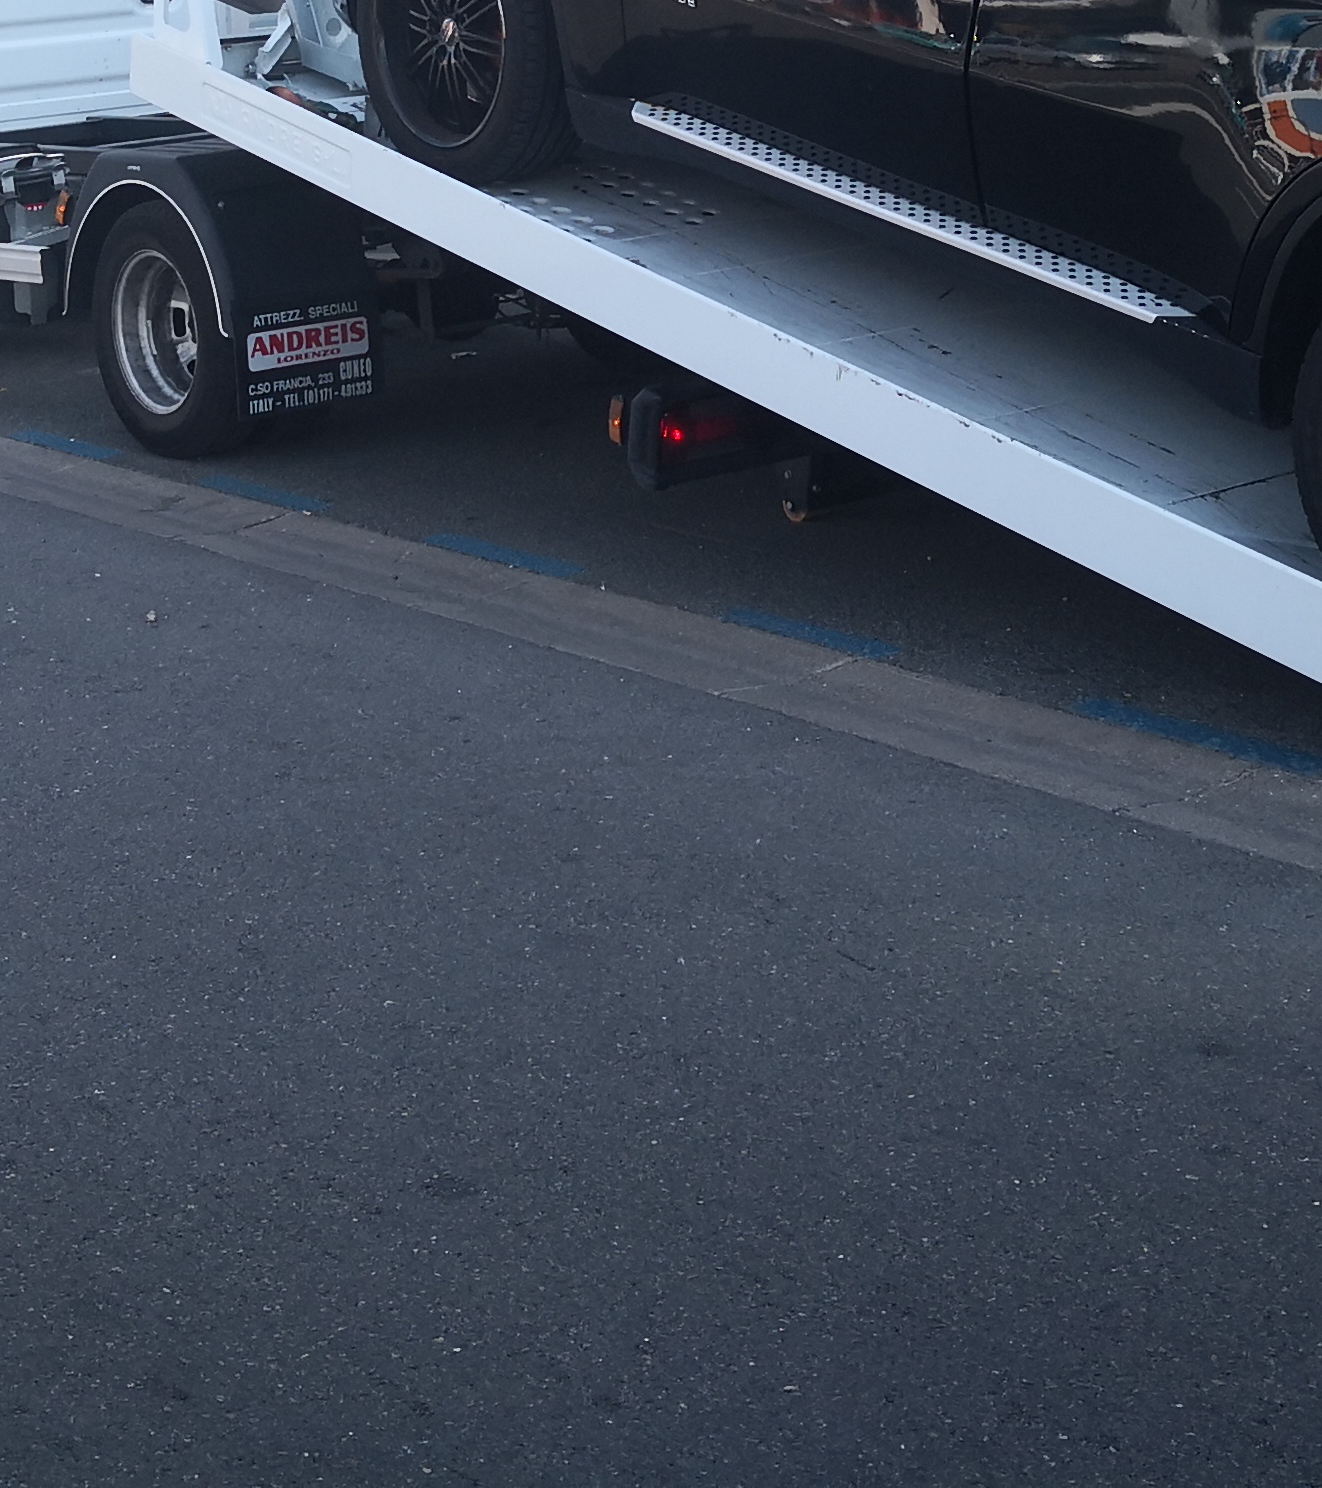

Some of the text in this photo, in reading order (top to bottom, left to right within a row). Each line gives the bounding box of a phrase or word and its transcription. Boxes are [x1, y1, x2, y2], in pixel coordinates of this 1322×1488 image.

[253, 300, 358, 328] ATTREZZ. SPECIALI
[250, 320, 366, 359] ANDREIS
[276, 348, 341, 364] LORENZO
[273, 375, 315, 392] FRANCIA,
[339, 357, 372, 380] CUNEO
[249, 397, 274, 414] ITALY
